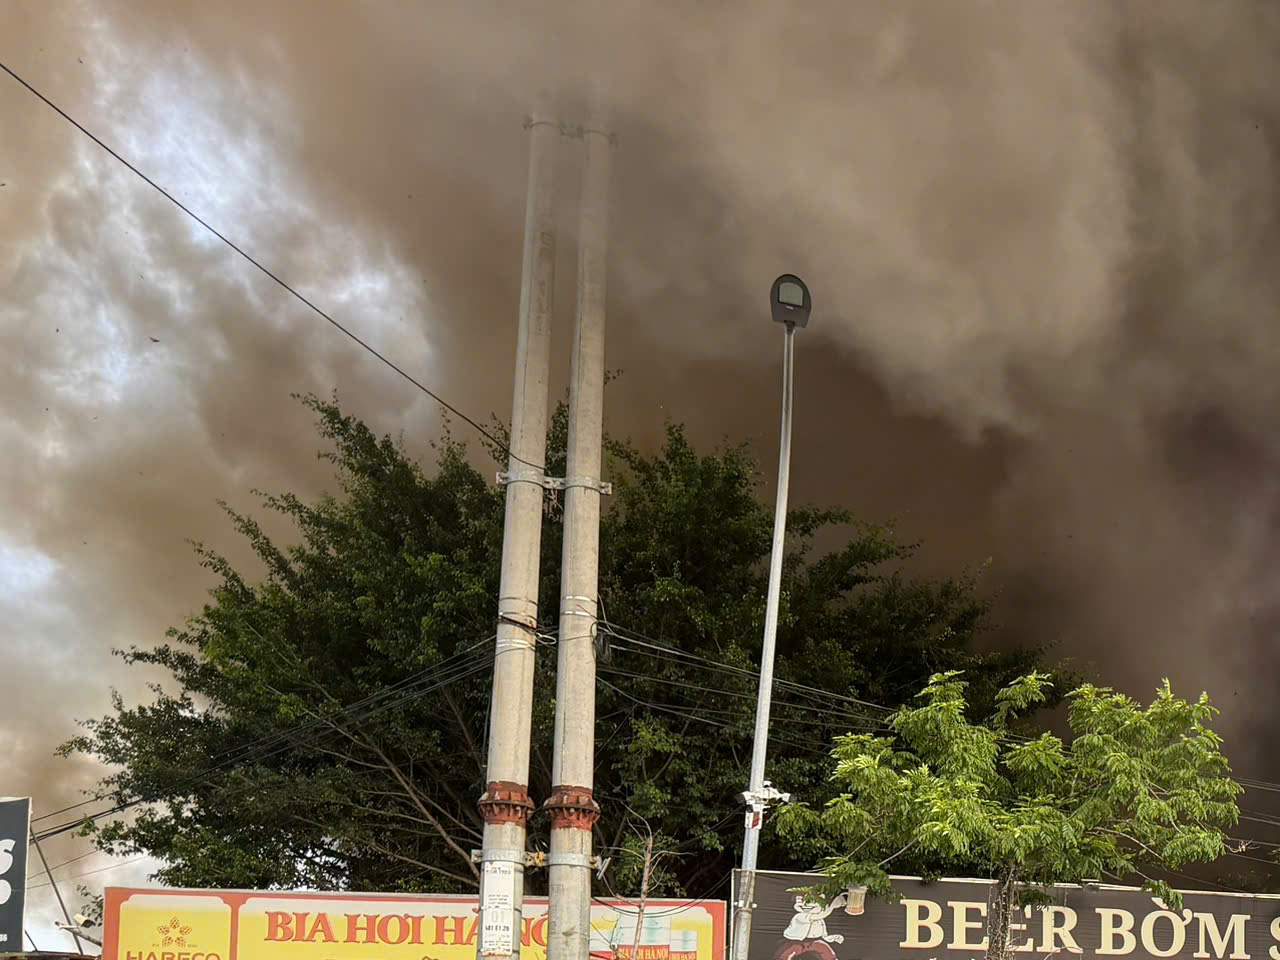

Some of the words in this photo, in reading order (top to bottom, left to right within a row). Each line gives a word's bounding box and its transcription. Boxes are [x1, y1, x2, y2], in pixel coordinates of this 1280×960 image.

[264, 911, 337, 943] BIA
[343, 913, 424, 945] HƠI
[900, 899, 1084, 954] BEER
[1095, 897, 1251, 960] BỜM
